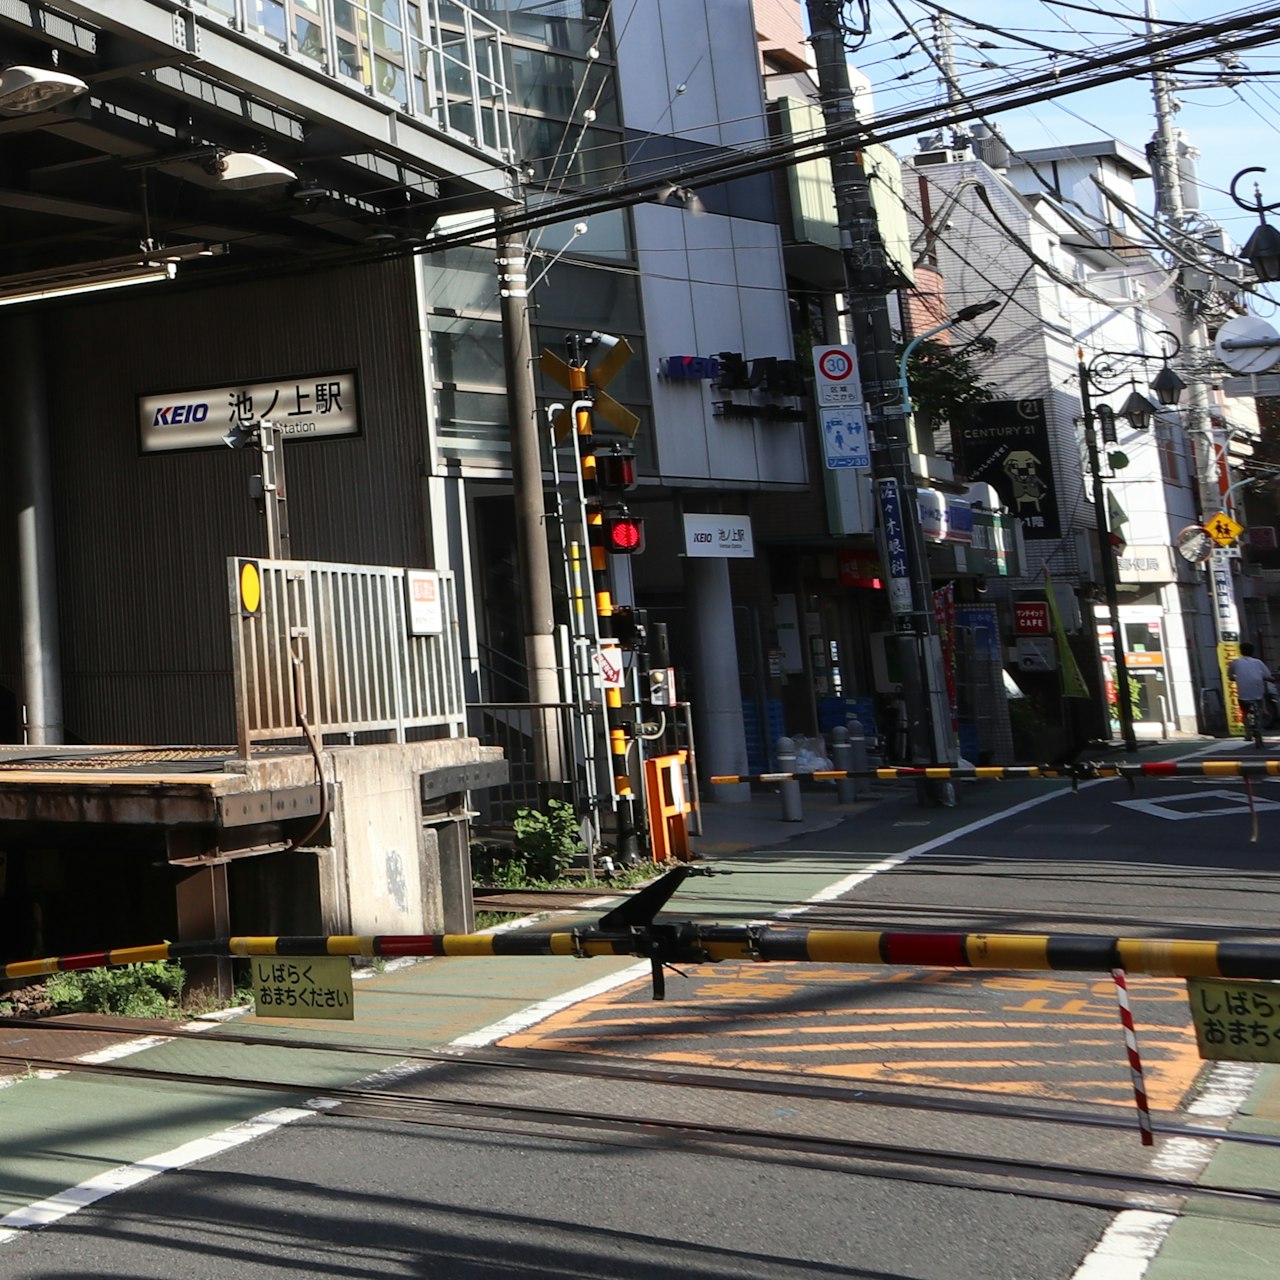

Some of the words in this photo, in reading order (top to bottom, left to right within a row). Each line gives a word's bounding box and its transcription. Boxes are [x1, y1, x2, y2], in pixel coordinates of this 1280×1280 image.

[825, 358, 846, 372] 30
[228, 381, 343, 423] 池ノ上駅
[1023, 401, 1038, 414] 21
[152, 403, 209, 426] KEIO
[964, 425, 1022, 439] CENTURY
[1023, 425, 1036, 435] 21
[693, 532, 713, 544] KEIO
[880, 481, 907, 576] 佐々木眼科
[1019, 618, 1044, 628] CAFE
[258, 963, 316, 985] しばらく
[260, 986, 350, 1008] おまちください
[1201, 989, 1280, 1018] しばら
